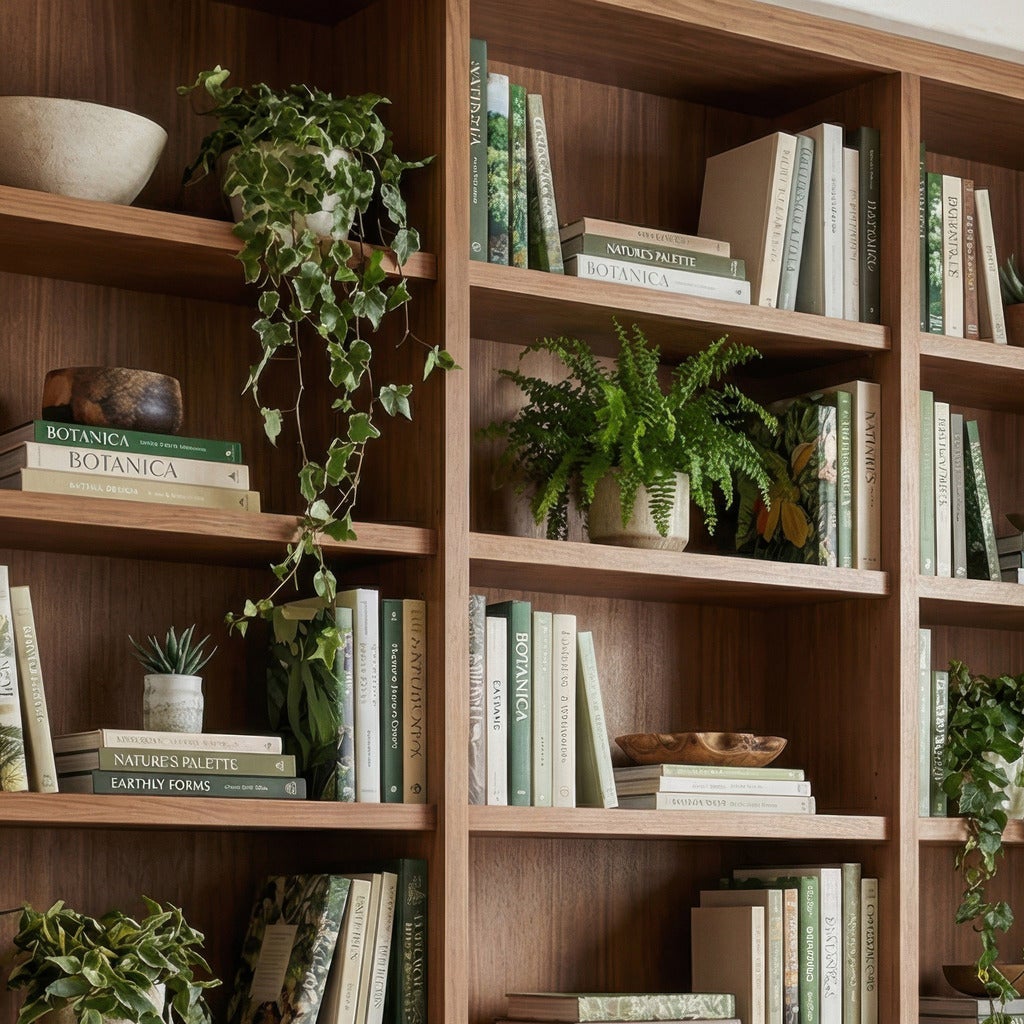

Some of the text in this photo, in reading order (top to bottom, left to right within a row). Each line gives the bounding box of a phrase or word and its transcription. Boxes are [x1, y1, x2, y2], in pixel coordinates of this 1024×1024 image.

[655, 251, 697, 267] PALETTE
[587, 261, 669, 288] BOTANICA
[47, 426, 129, 447] BOTANICA
[69, 451, 177, 479] BOTANICA
[515, 632, 529, 722] BOTANICA
[114, 753, 239, 771] NATURES PALETTE
[111, 777, 165, 790] EARTHLY
[169, 779, 211, 792] FORMS
